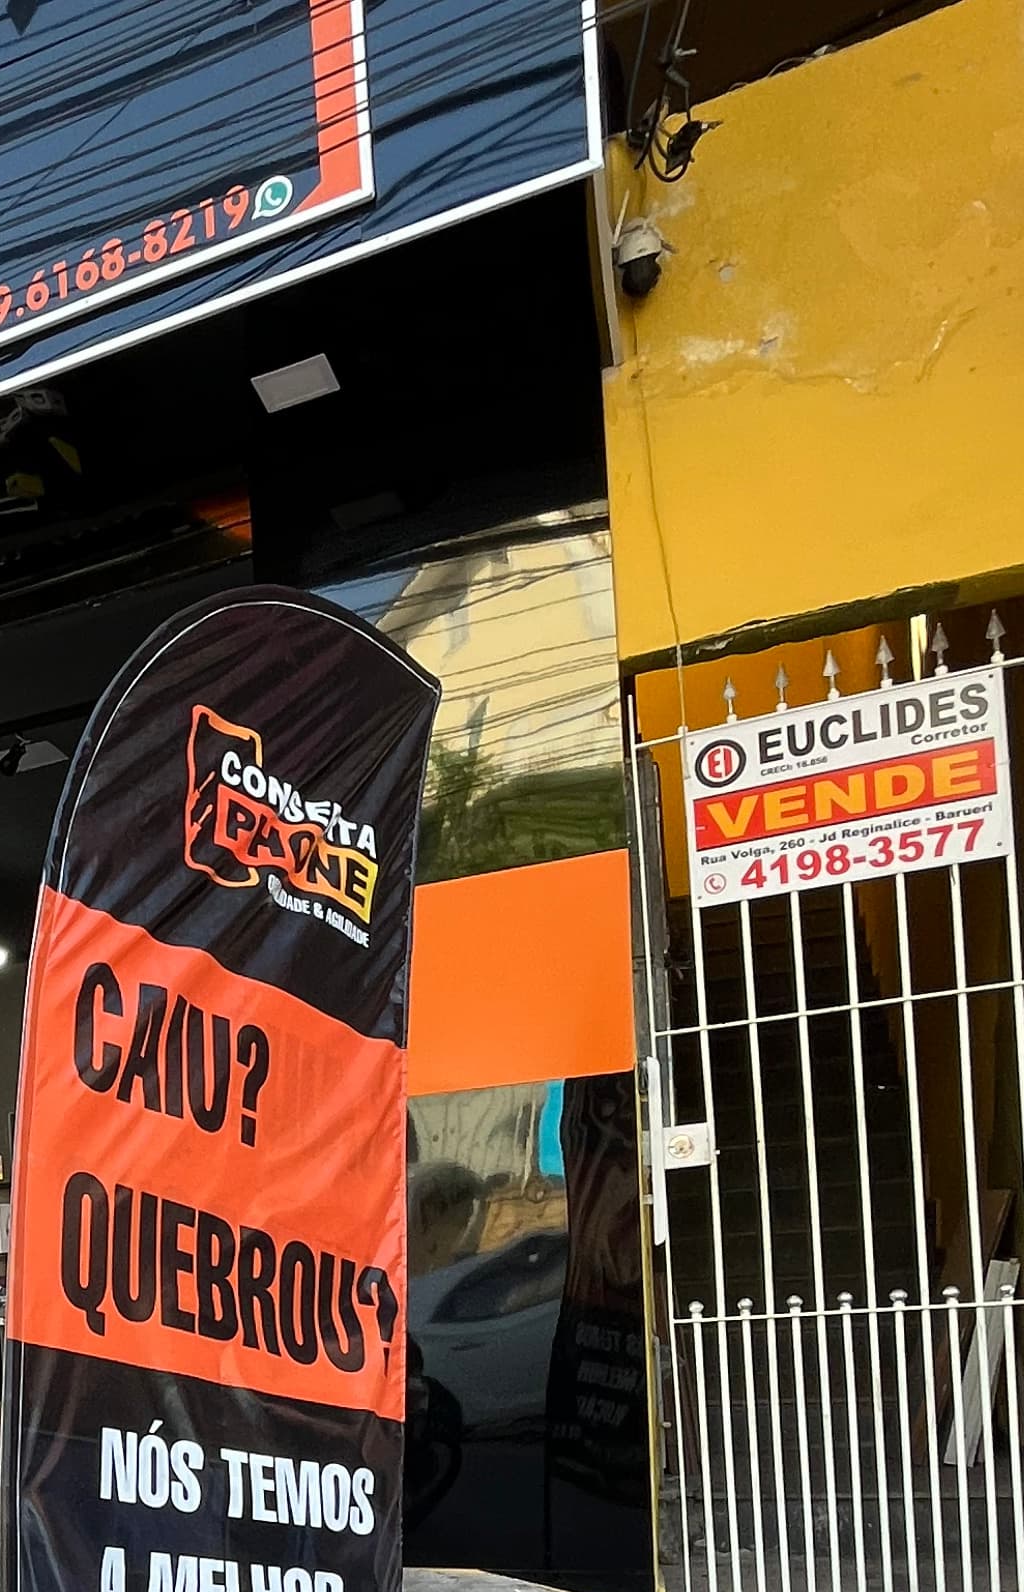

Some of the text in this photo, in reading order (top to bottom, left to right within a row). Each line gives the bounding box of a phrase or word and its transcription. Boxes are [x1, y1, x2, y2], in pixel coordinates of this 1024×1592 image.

[758, 683, 989, 764] EUCLIDES
[911, 720, 988, 746] Corretor
[701, 854, 727, 866] Rua
[731, 845, 775, 860] Volga,
[779, 837, 805, 851] 260
[819, 831, 837, 844] Jd
[842, 817, 921, 839] Reginalice
[935, 801, 993, 822] Barueri
[707, 750, 982, 840] VENDE
[226, 798, 369, 909] PHONE
[740, 818, 985, 889] 4198-3577
[313, 901, 324, 920] &
[325, 907, 370, 949] AGILIDADE
[74, 962, 270, 1148] CAIU?
[61, 1172, 399, 1378] QUEBROU?
[99, 1419, 375, 1536] NÓS TEMOS
